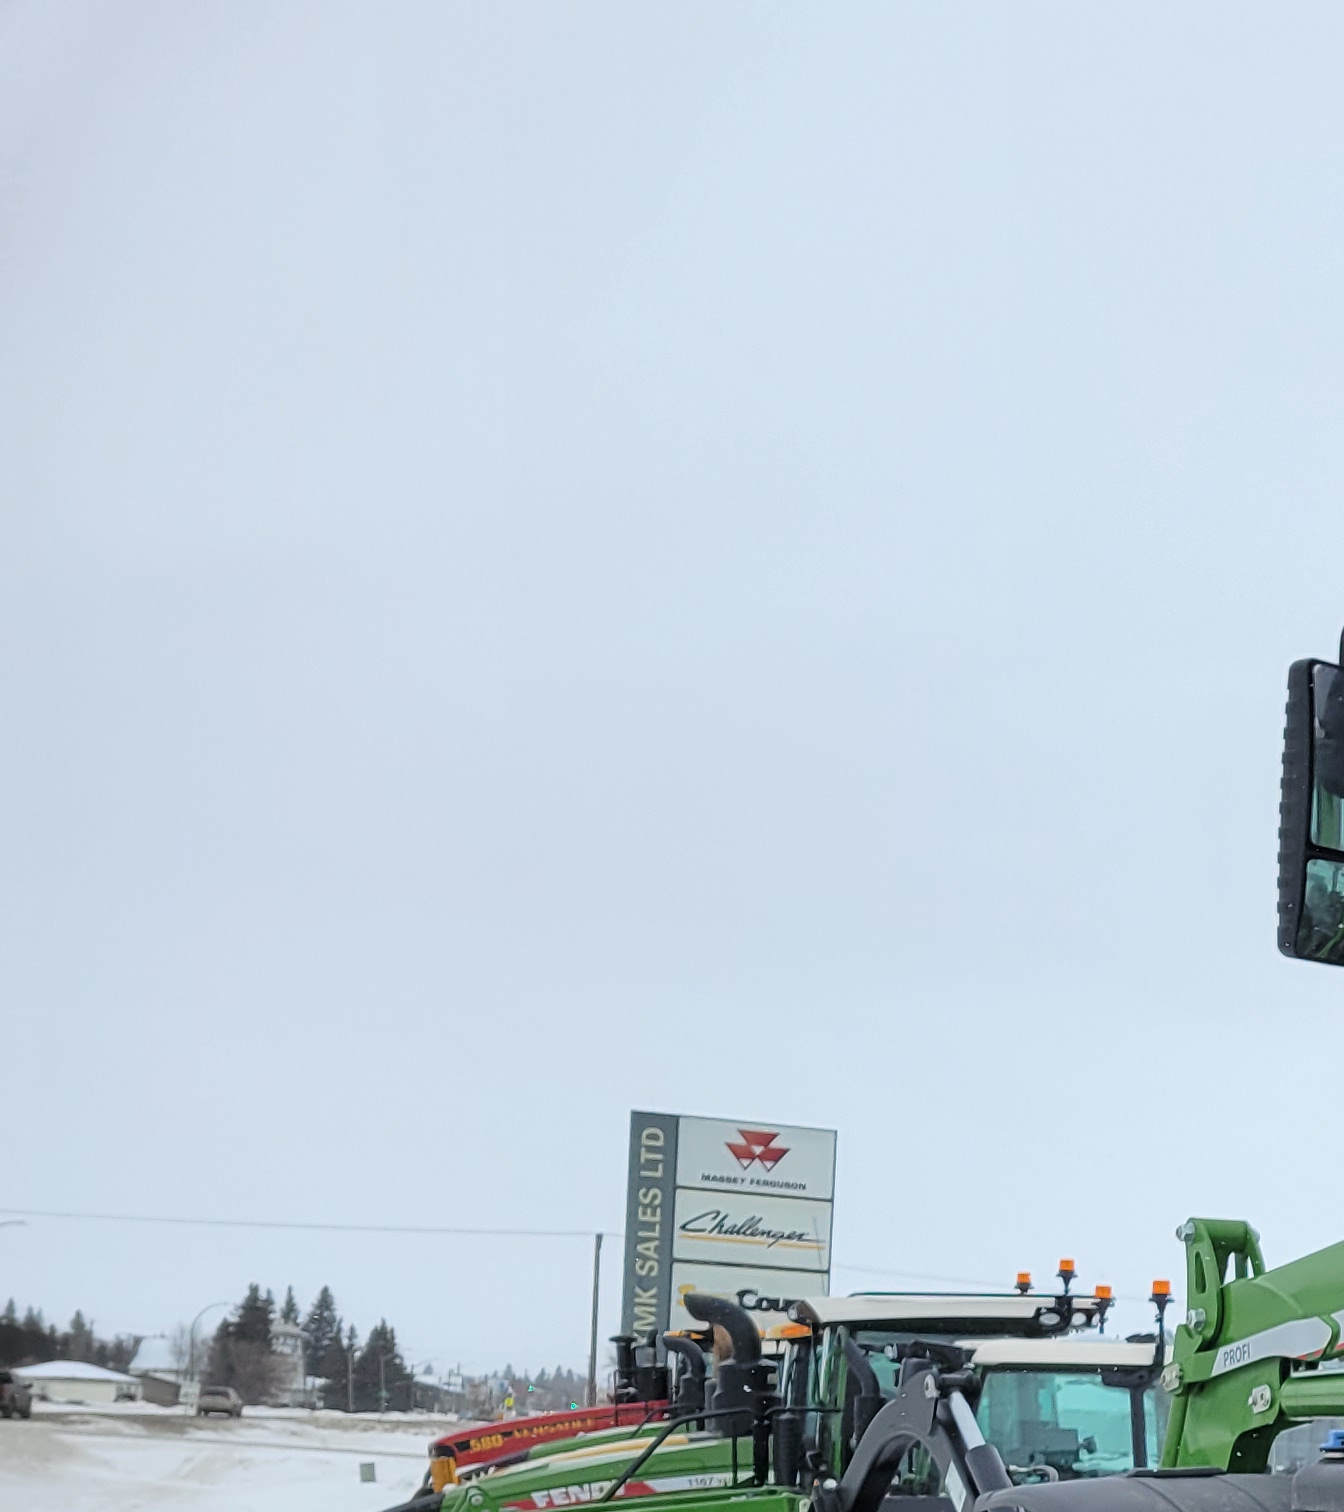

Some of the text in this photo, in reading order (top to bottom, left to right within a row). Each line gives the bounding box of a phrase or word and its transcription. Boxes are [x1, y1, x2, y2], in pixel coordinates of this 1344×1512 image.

[640, 1125, 666, 1178] LTD
[701, 1173, 807, 1191] MASSEY FERGUSON
[635, 1186, 663, 1278] SALES
[680, 1209, 826, 1249] Challenger
[1223, 1344, 1251, 1368] PROFI
[469, 1433, 504, 1452] 580
